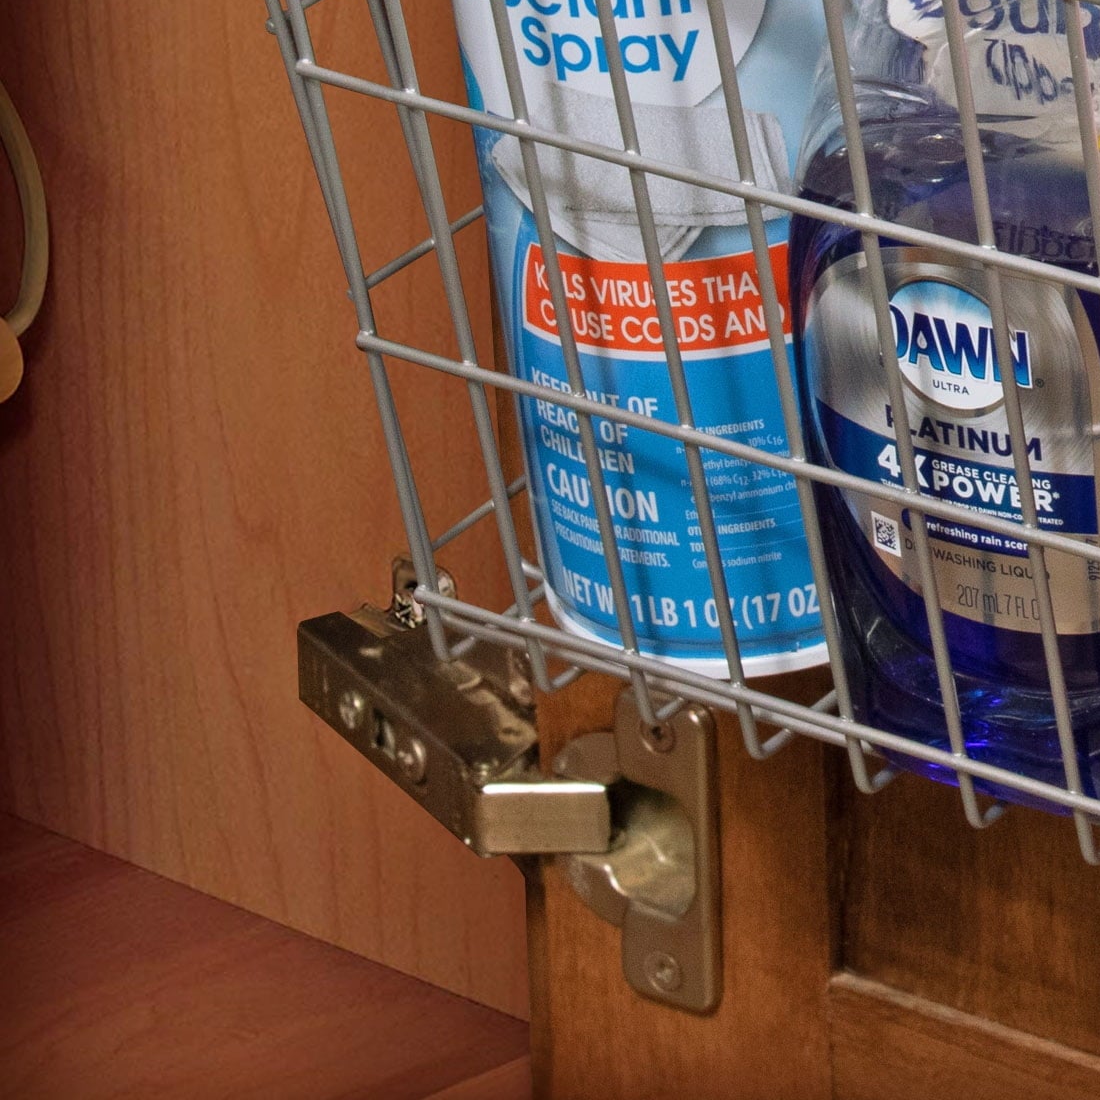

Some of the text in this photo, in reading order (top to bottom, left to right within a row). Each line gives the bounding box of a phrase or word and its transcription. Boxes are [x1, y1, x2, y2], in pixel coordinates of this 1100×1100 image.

[534, 261, 760, 308] KLS VIRUES THA
[540, 298, 615, 341] CUSE
[621, 314, 716, 344] CODS
[932, 379, 970, 396] ULTRA
[536, 399, 628, 445] REAC OF
[885, 403, 1043, 462] PATINUM
[931, 459, 979, 479] GREASE
[983, 471, 1051, 490] CLEANG
[547, 462, 660, 523] CAUION
[580, 513, 600, 534] PANE
[926, 521, 1003, 547] refreshing rain
[617, 546, 671, 568] TATEMENTS.
[905, 538, 997, 573] DWASHING
[562, 566, 592, 607] NET
[594, 582, 614, 615] W
[631, 594, 644, 623] 1
[648, 595, 679, 628] LB
[683, 599, 697, 629] 1
[742, 592, 781, 630] (17
[956, 584, 979, 609] 207
[982, 593, 1003, 615] mL
[1004, 594, 1012, 616] 7
